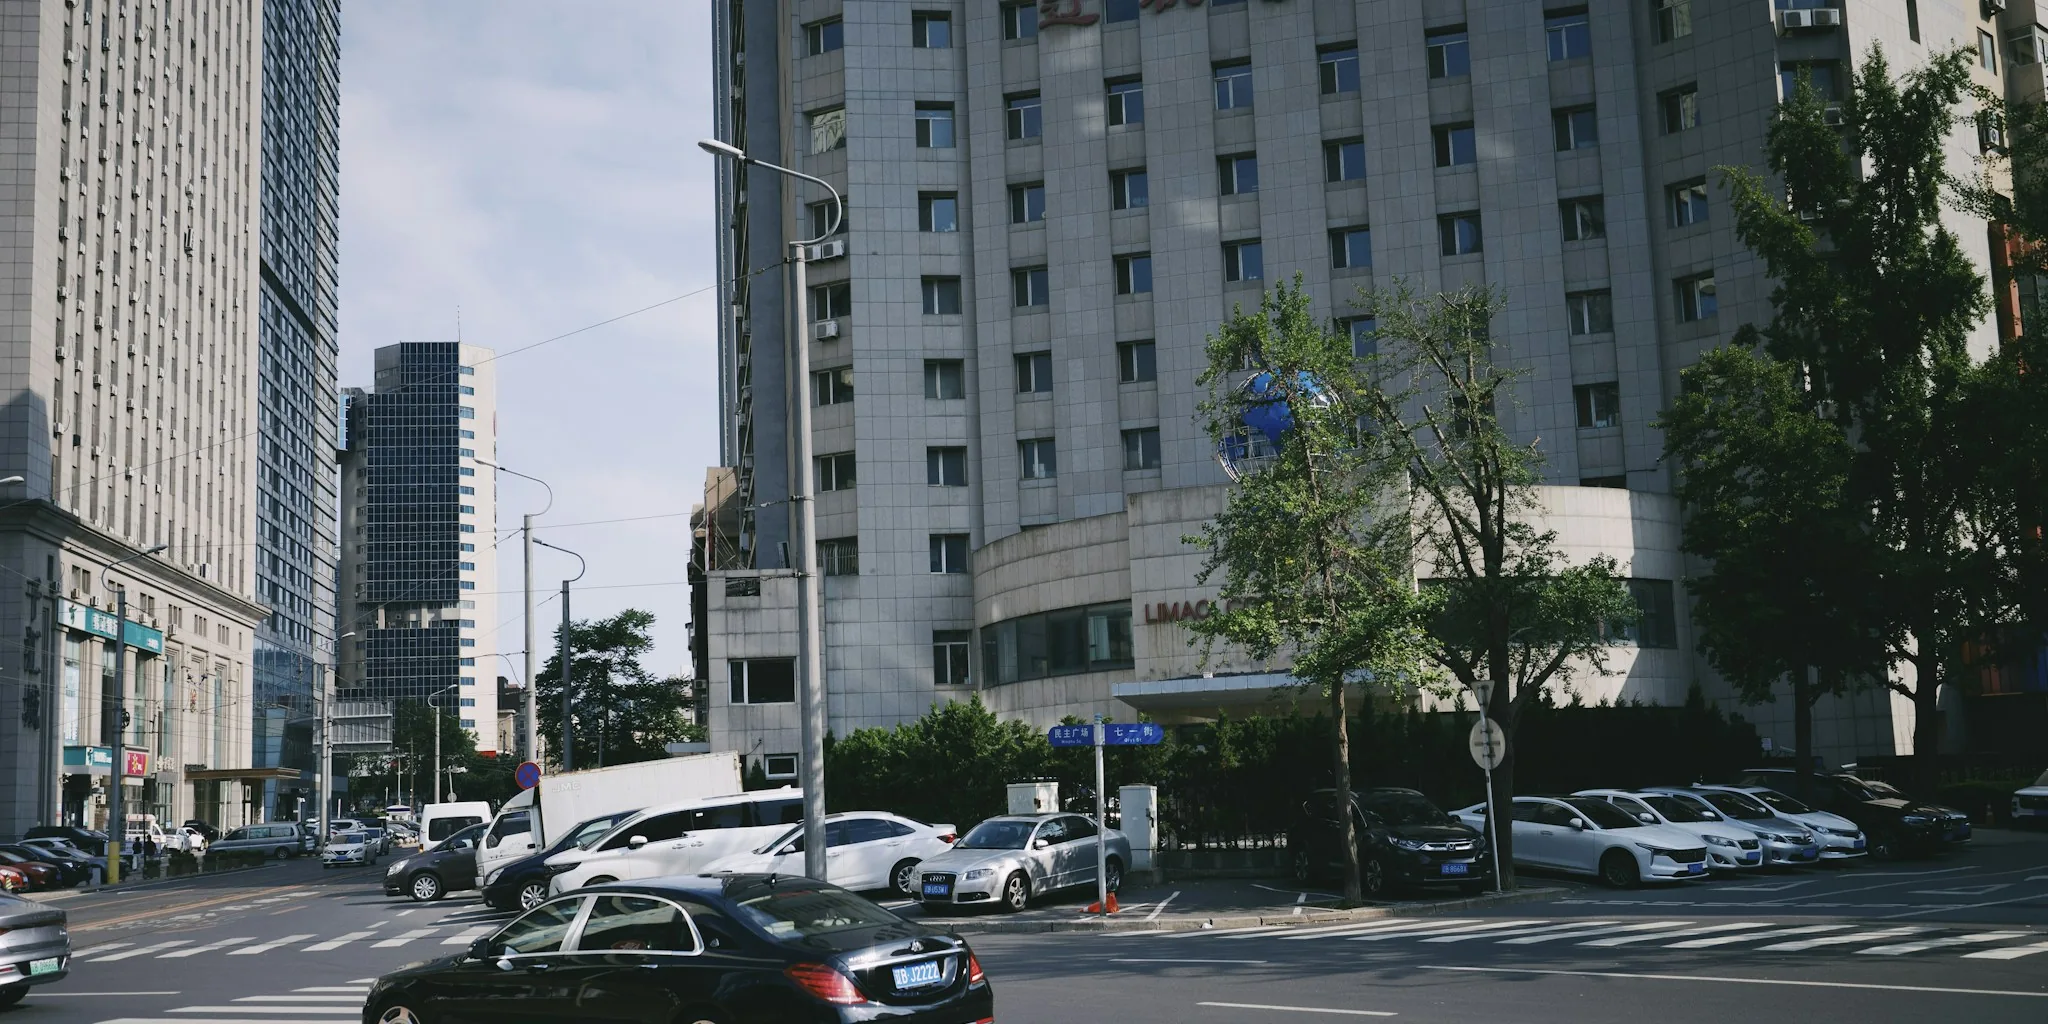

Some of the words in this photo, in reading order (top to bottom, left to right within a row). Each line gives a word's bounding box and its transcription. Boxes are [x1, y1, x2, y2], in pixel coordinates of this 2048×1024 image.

[1054, 727, 1089, 739] 民主广场
[1114, 726, 1153, 737] 七一街
[552, 781, 581, 793] JMC
